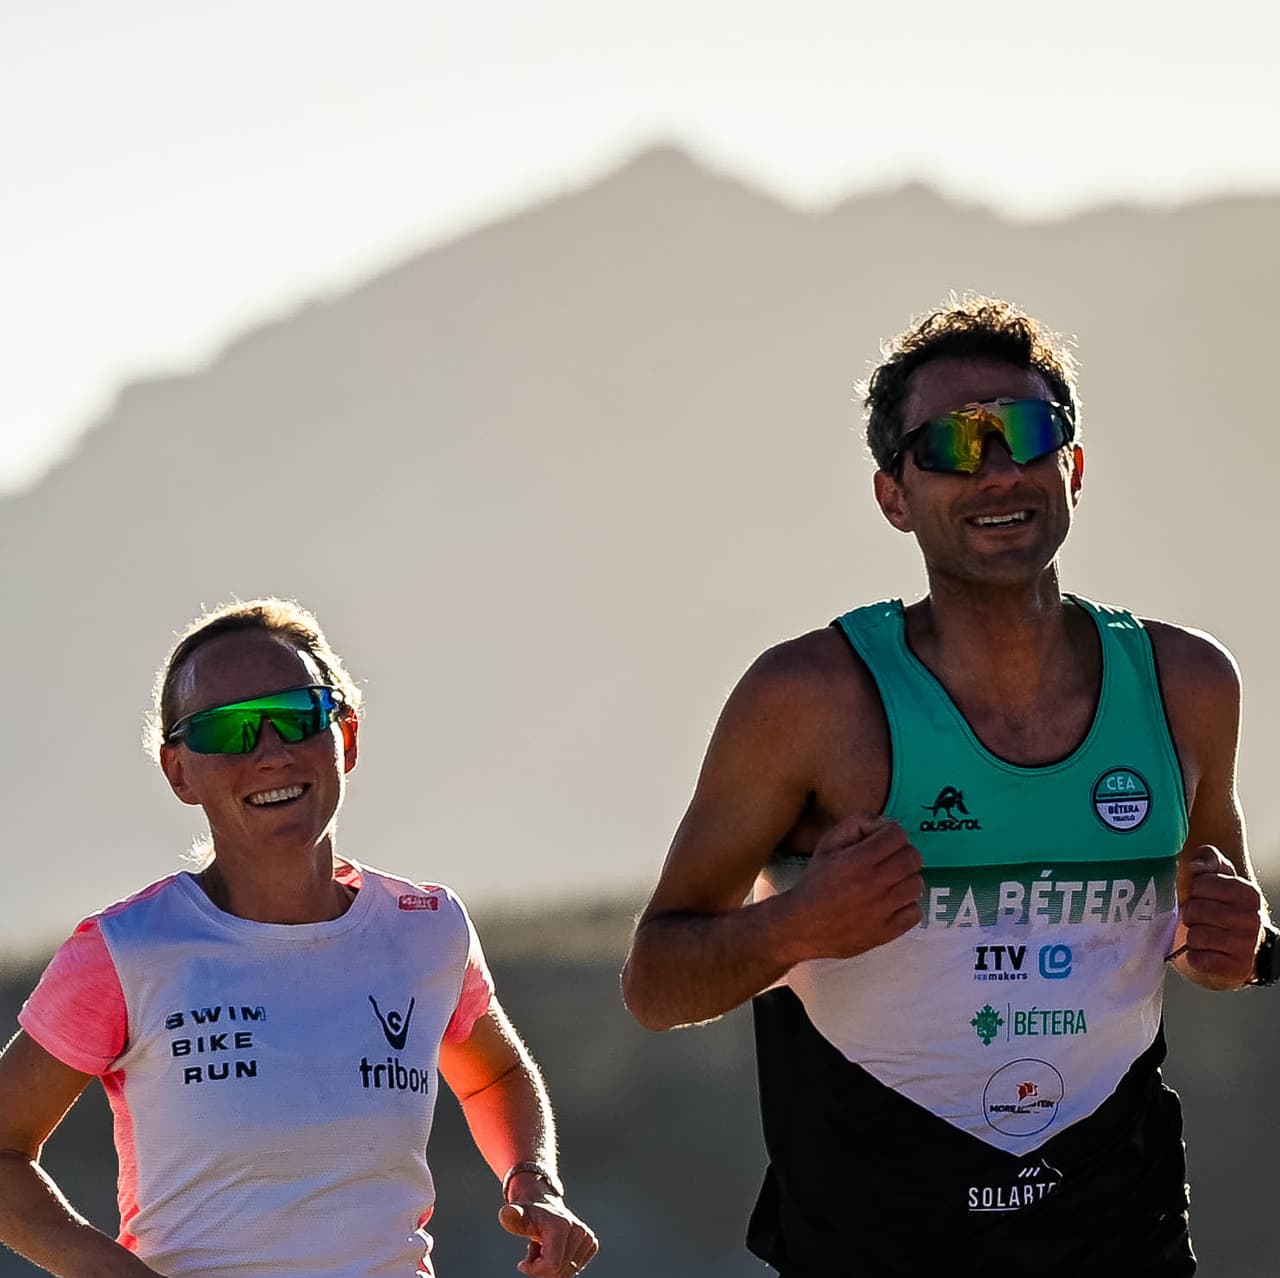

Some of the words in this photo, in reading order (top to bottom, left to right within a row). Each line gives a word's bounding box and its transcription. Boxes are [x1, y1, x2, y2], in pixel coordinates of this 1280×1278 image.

[1106, 775, 1136, 790] CEA
[927, 884, 980, 929] EA
[996, 869, 1158, 927] BÉTERA
[974, 945, 1027, 971] ITV
[165, 1006, 266, 1030] SWIM
[1014, 1006, 1087, 1036] BÉTERA
[171, 1031, 253, 1057] BIKE
[183, 1060, 257, 1084] RUN
[359, 1056, 428, 1095] tribox
